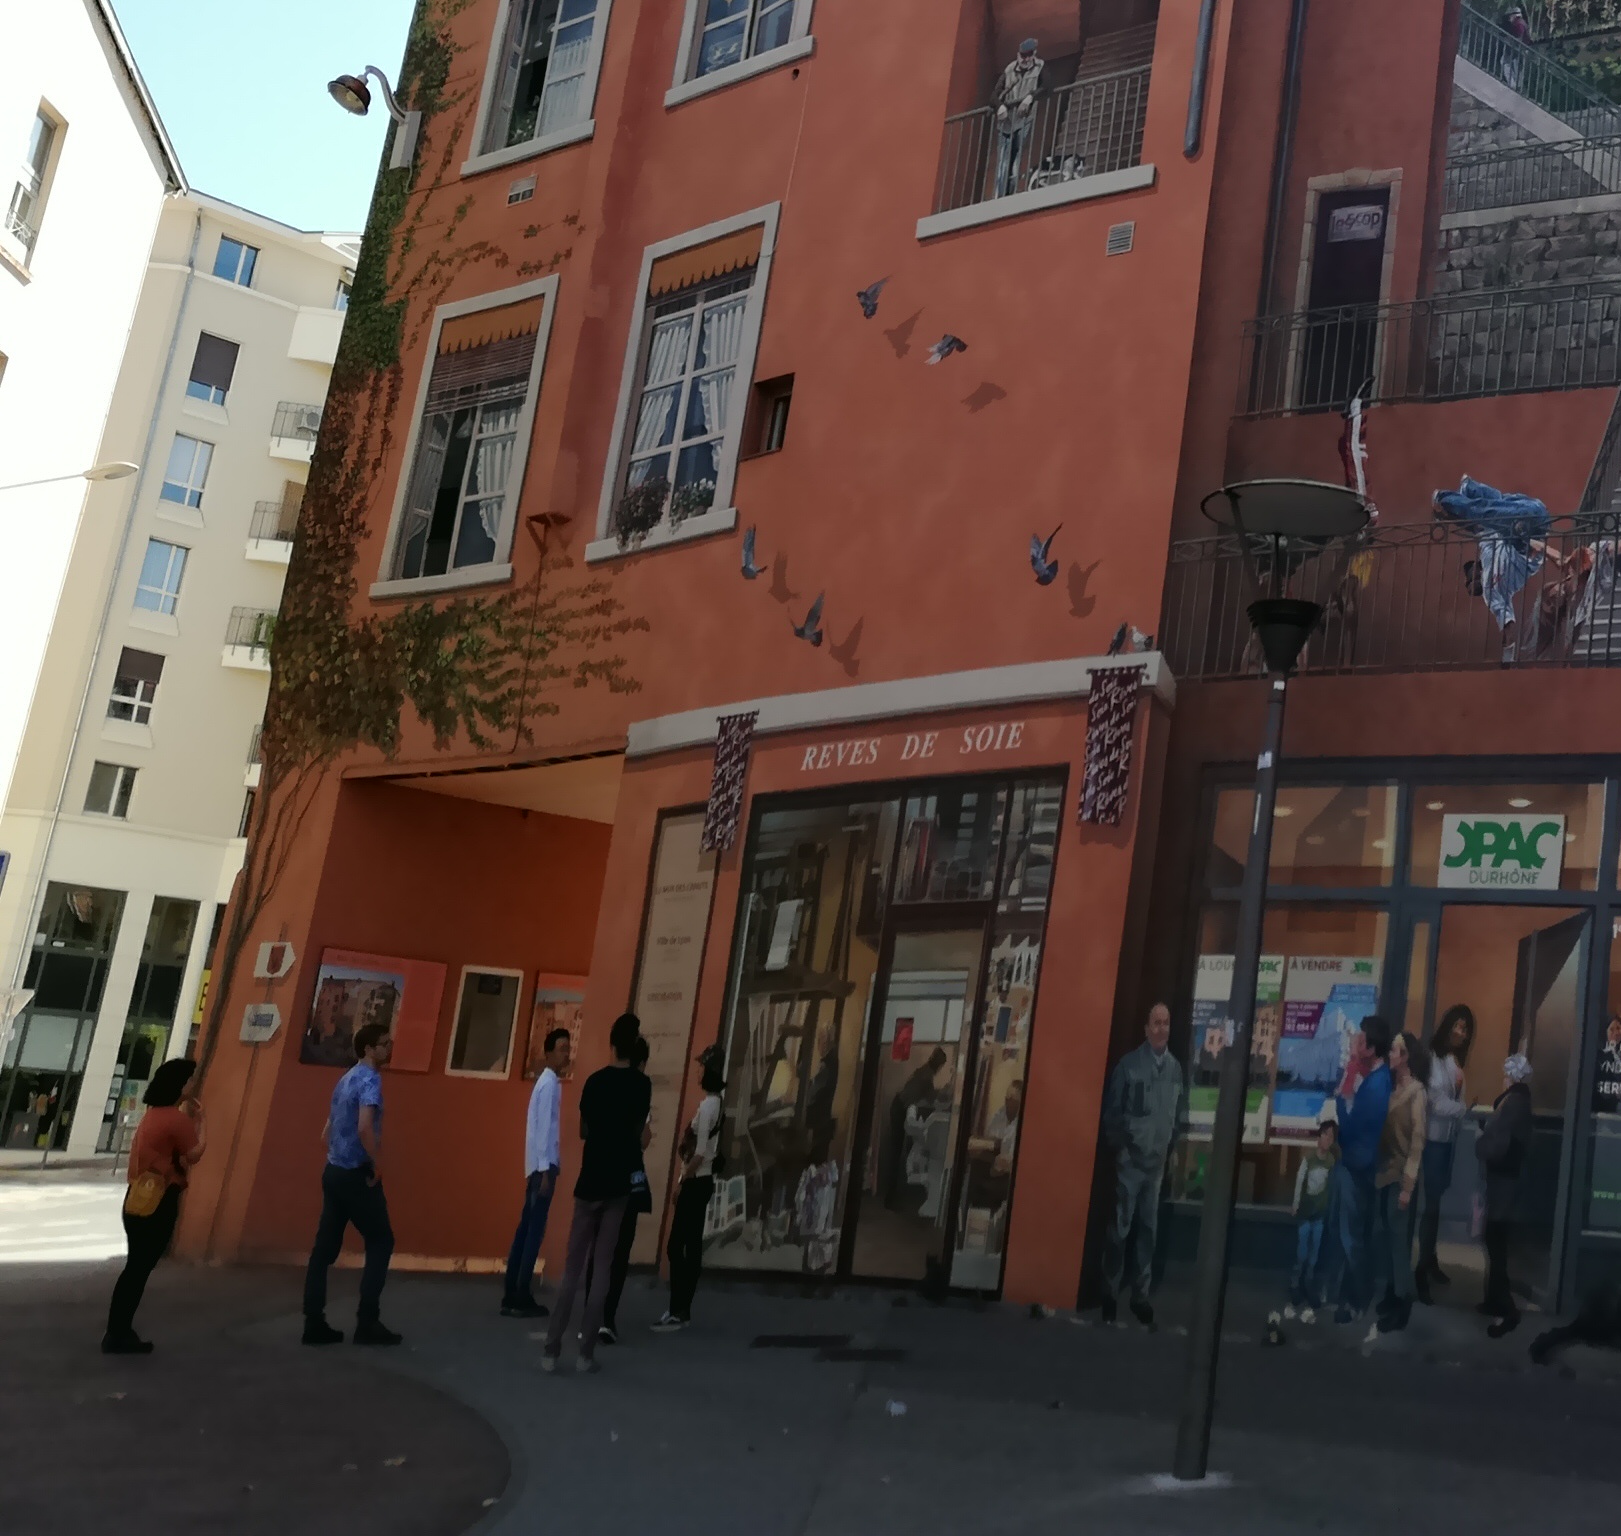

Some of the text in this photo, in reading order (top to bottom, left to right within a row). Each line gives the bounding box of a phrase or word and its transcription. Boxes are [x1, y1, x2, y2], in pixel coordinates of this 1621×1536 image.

[800, 722, 1025, 771] REVES DE SOIE
